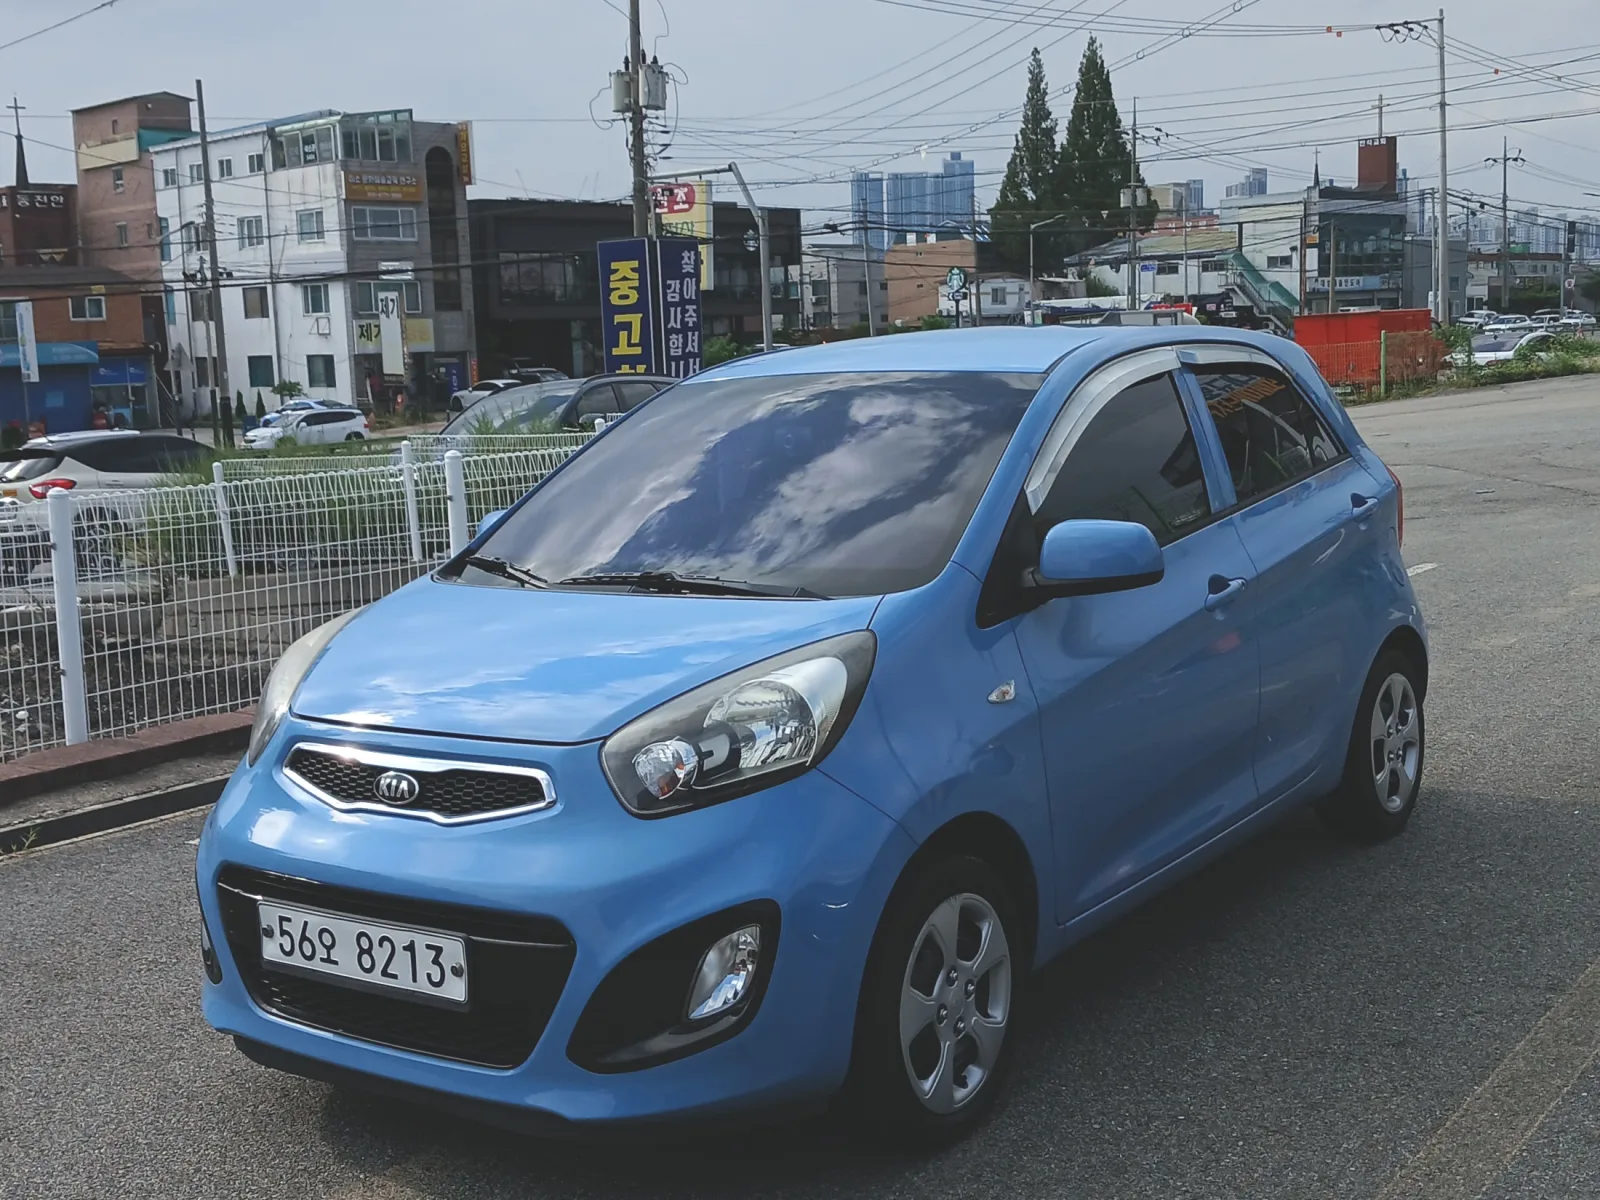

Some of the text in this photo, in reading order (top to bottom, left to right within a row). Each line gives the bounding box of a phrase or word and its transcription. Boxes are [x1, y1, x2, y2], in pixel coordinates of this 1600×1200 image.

[379, 777, 409, 798] KIA
[277, 914, 446, 988] 56오 8213
